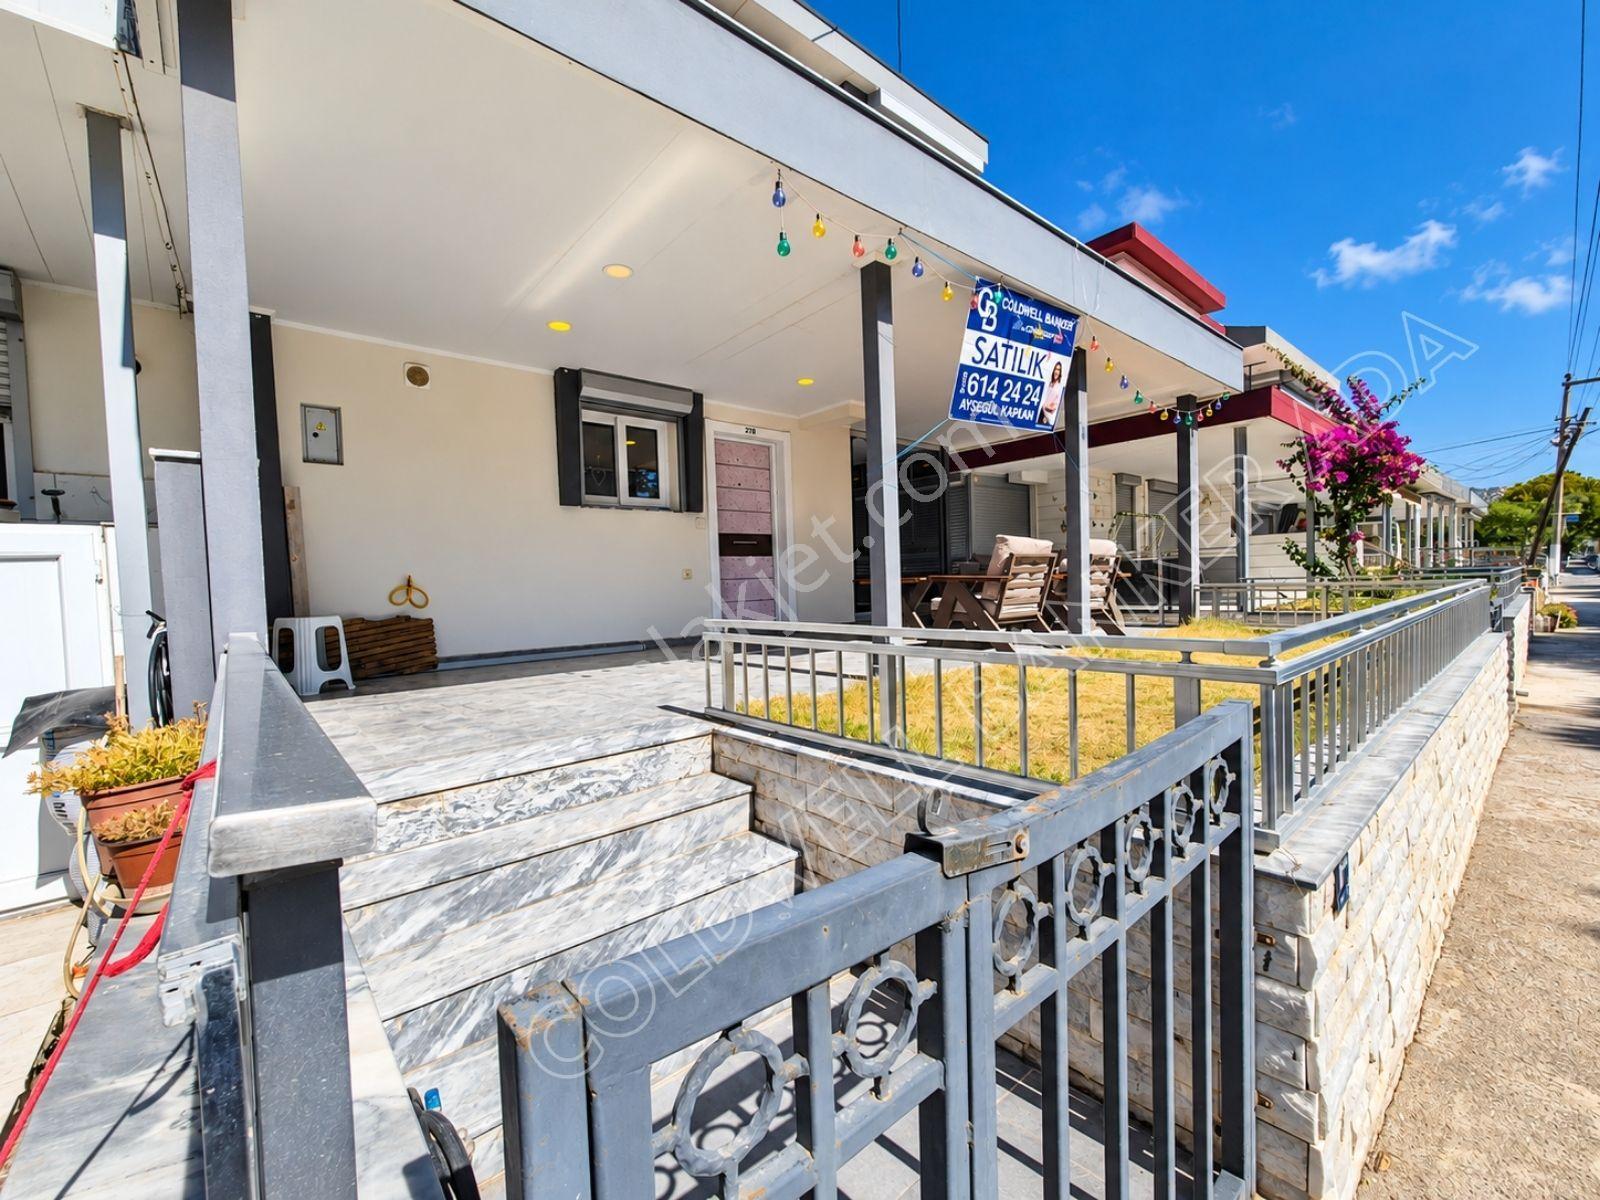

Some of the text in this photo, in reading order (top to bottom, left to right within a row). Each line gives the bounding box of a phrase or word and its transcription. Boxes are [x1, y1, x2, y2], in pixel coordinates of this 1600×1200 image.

[1001, 297, 1075, 332] COLDWELL BANKER
[971, 335, 1048, 380] SATILIK
[967, 372, 999, 400] 614
[1000, 379, 1021, 404] 24
[1021, 385, 1042, 407] 24
[1000, 404, 1035, 421] KAPLAN
